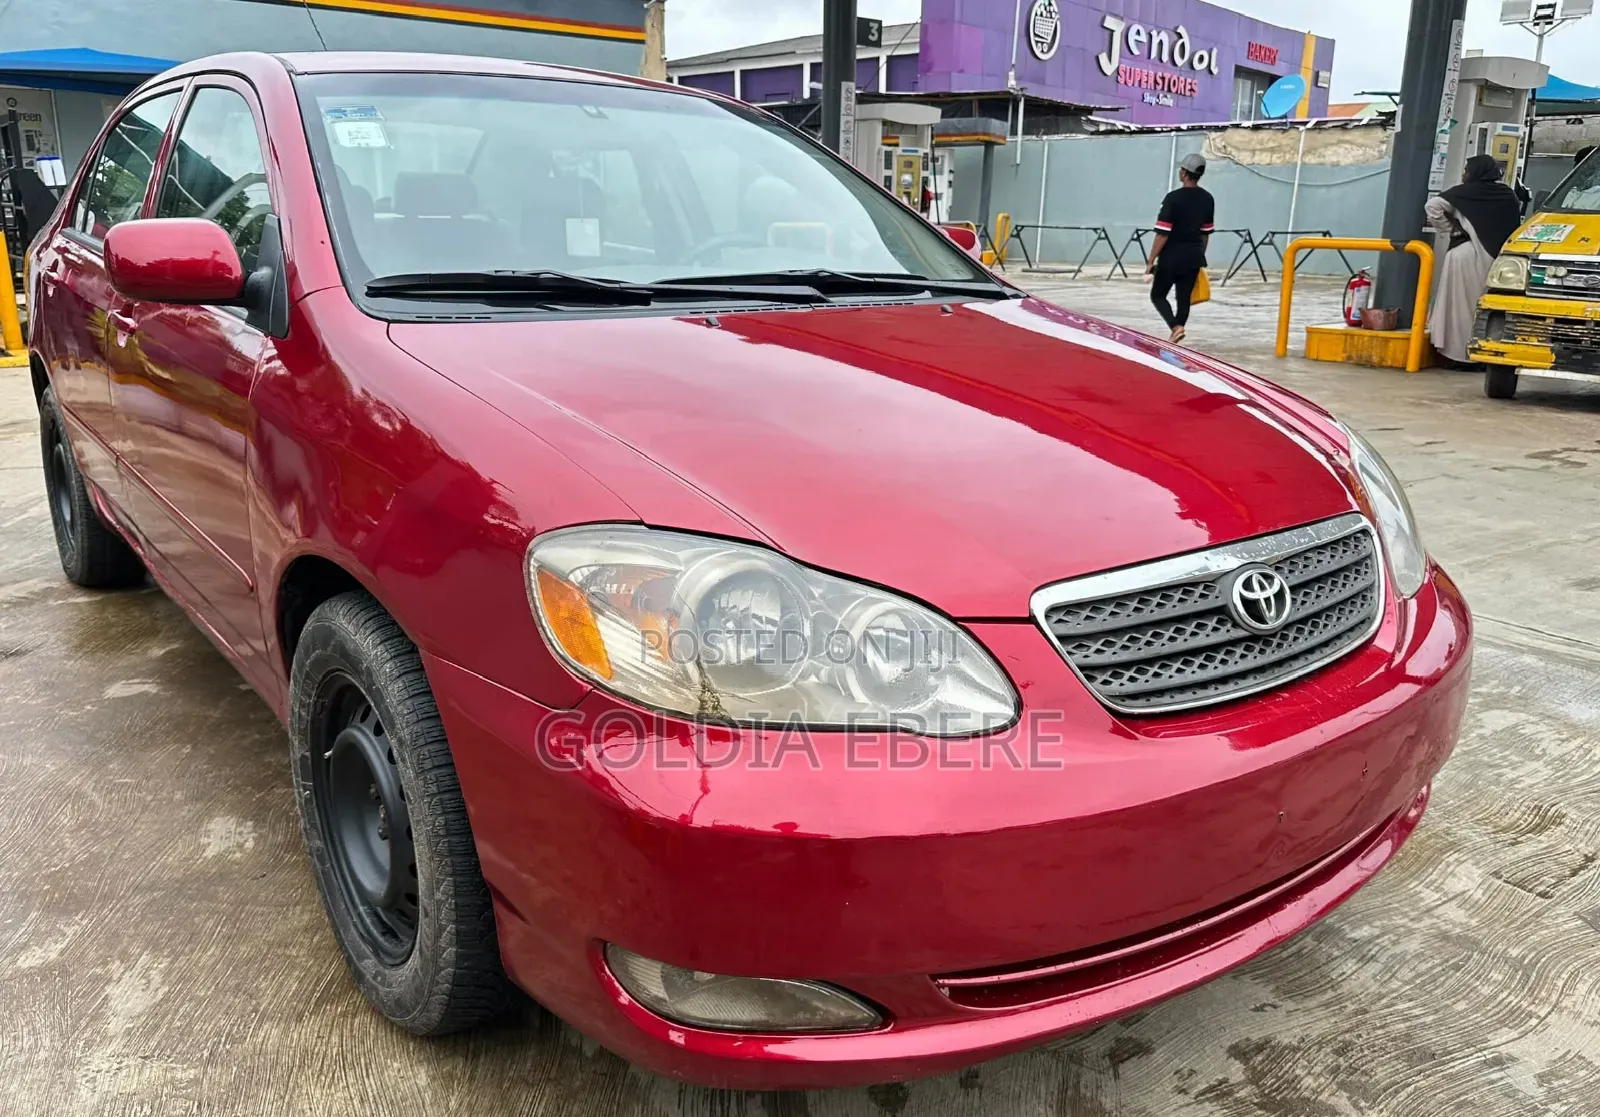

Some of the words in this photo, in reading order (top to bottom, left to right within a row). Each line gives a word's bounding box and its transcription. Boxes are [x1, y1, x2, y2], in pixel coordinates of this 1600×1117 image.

[868, 22, 879, 42] 3
[1248, 41, 1278, 66] BAKERY
[19, 112, 42, 122] reen
